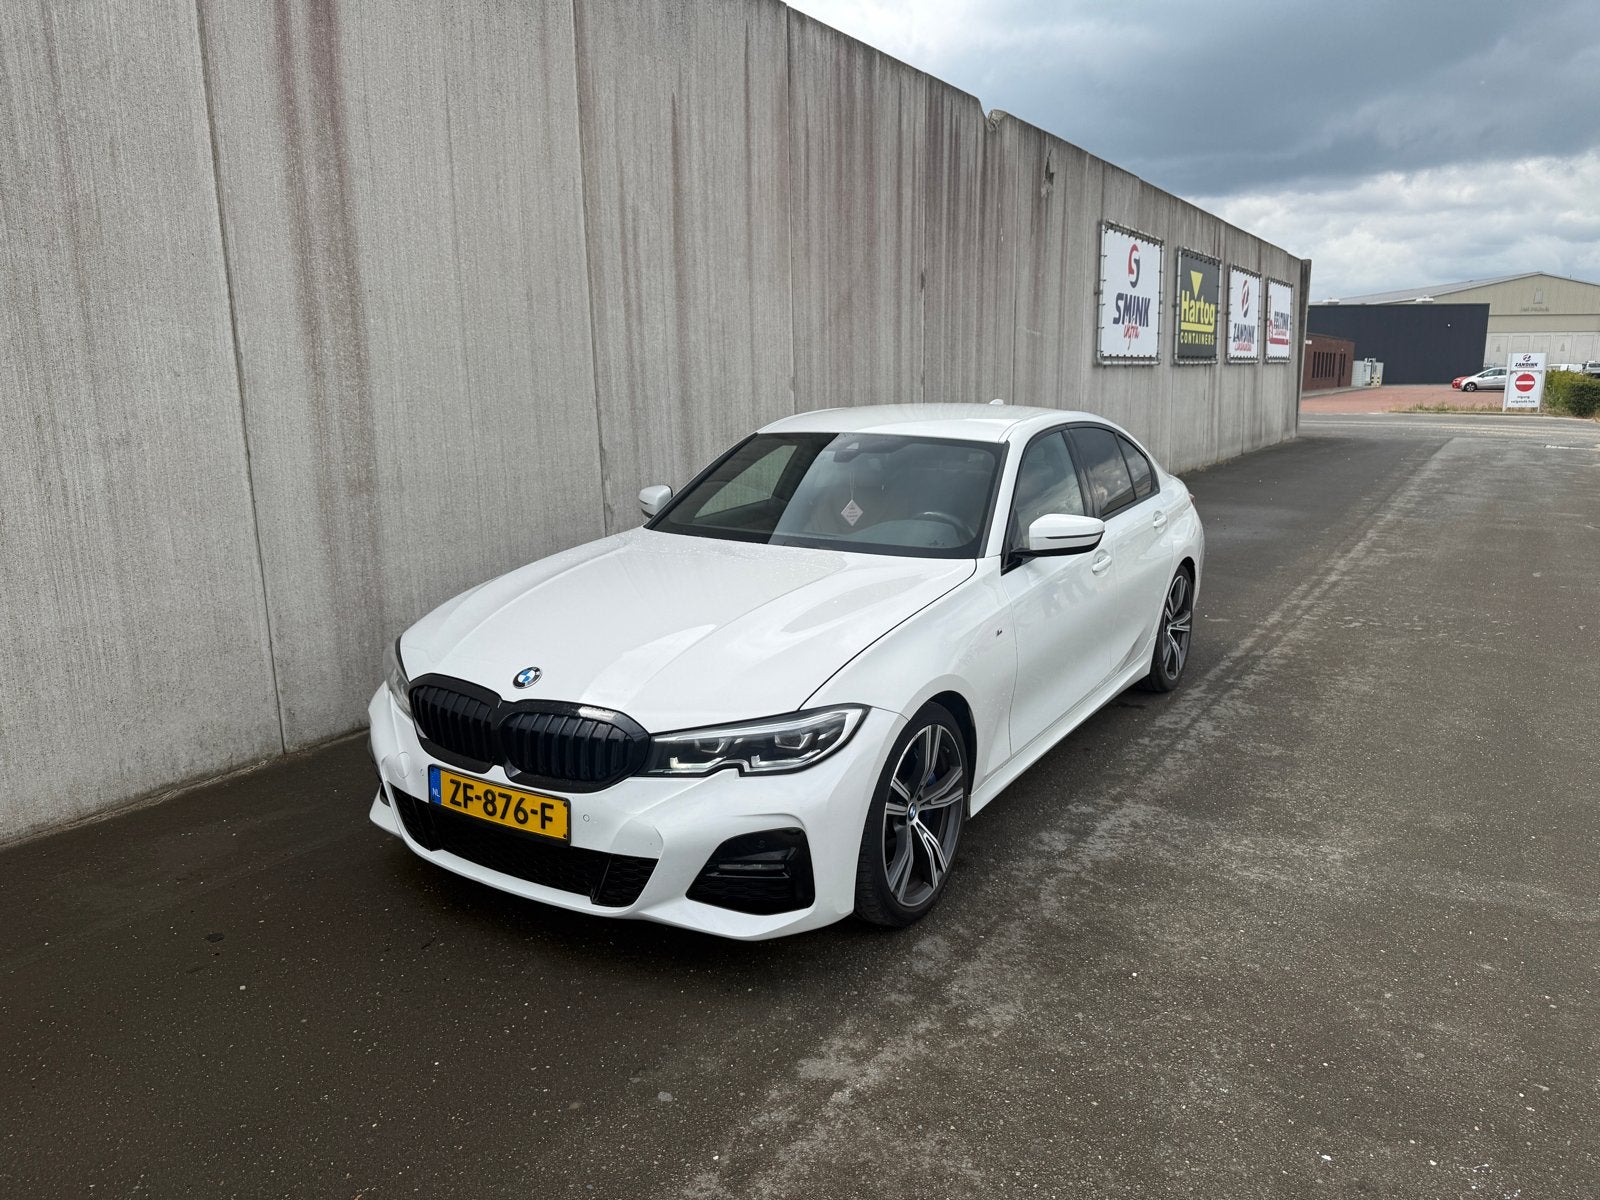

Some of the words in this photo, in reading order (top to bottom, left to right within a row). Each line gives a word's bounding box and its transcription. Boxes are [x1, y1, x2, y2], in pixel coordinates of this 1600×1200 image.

[1112, 292, 1151, 328] SMINK
[1181, 289, 1216, 328] Hartog
[1179, 333, 1215, 346] CONTAINERS
[432, 787, 441, 798] NL
[449, 778, 555, 830] ZF-876-F
